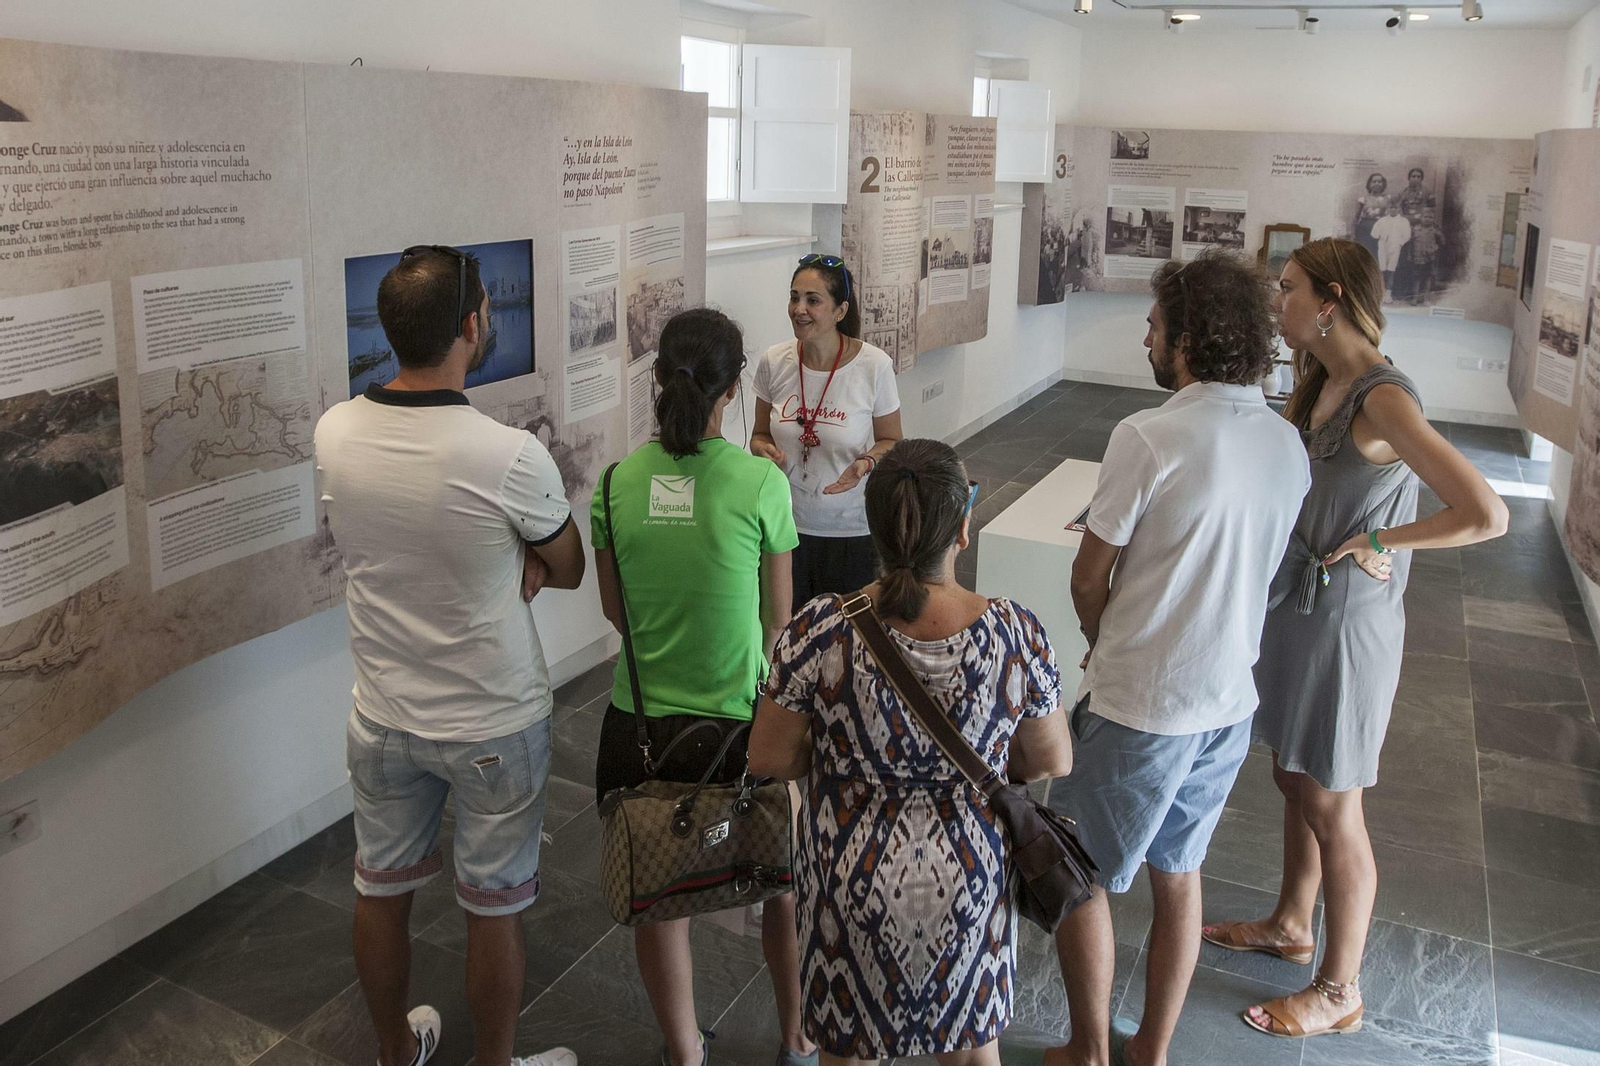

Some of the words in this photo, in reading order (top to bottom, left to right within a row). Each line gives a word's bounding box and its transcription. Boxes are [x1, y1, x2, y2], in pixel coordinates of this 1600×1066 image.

[32, 142, 57, 156] Cruz
[60, 141, 83, 155] nació
[84, 146, 91, 158] y
[93, 142, 113, 157] pasó
[129, 140, 156, 153] niñez
[158, 144, 164, 156] y
[167, 140, 230, 153] adolescencia
[233, 144, 245, 152] en
[584, 139, 593, 148] en
[594, 135, 602, 147] la
[603, 135, 614, 147] Isla
[615, 135, 622, 147] de
[43, 164, 61, 173] una
[62, 158, 92, 172] ciudad
[94, 162, 111, 170] con
[114, 161, 131, 170] una
[134, 157, 157, 174] larga
[161, 156, 199, 169] historia
[202, 155, 250, 167] vinculada
[563, 153, 576, 169] Ay,
[577, 152, 591, 164] Isla
[593, 152, 601, 164] de
[885, 156, 893, 168] El
[896, 156, 915, 168] barrio
[1056, 154, 1067, 179] 3
[563, 172, 591, 186] porque
[592, 168, 603, 180] del
[604, 169, 623, 183] puente
[860, 156, 880, 193] 2
[885, 171, 895, 182] las
[3, 185, 9, 198] y
[12, 184, 33, 197] que
[35, 177, 66, 195] ejerció
[69, 181, 85, 190] una
[88, 180, 107, 192] gran
[110, 173, 158, 187] influencia
[160, 172, 187, 184] sobre
[190, 171, 217, 186] aquel
[221, 170, 272, 182] muchacho
[564, 190, 574, 198] no
[576, 184, 593, 201] pasó
[9, 198, 53, 215] delgado.
[22, 219, 43, 231] Cruz
[61, 217, 77, 226] born
[80, 214, 92, 224] and
[93, 214, 112, 225] spent
[114, 211, 123, 220] his
[125, 207, 163, 219] childhood
[165, 206, 179, 217] and
[182, 205, 228, 216] adolescence
[230, 204, 238, 212] in
[39, 232, 58, 242] town
[60, 229, 76, 240] with
[83, 227, 98, 238] long
[100, 223, 140, 235] relationship
[142, 222, 150, 230] to
[152, 220, 164, 229] the
[180, 217, 195, 227] that
[198, 216, 212, 226] had
[220, 216, 245, 226] strong
[13, 250, 25, 259] on
[27, 247, 42, 257] this
[63, 241, 87, 252] blonde
[782, 394, 847, 421] Camarón
[652, 502, 690, 514] Vaguada
